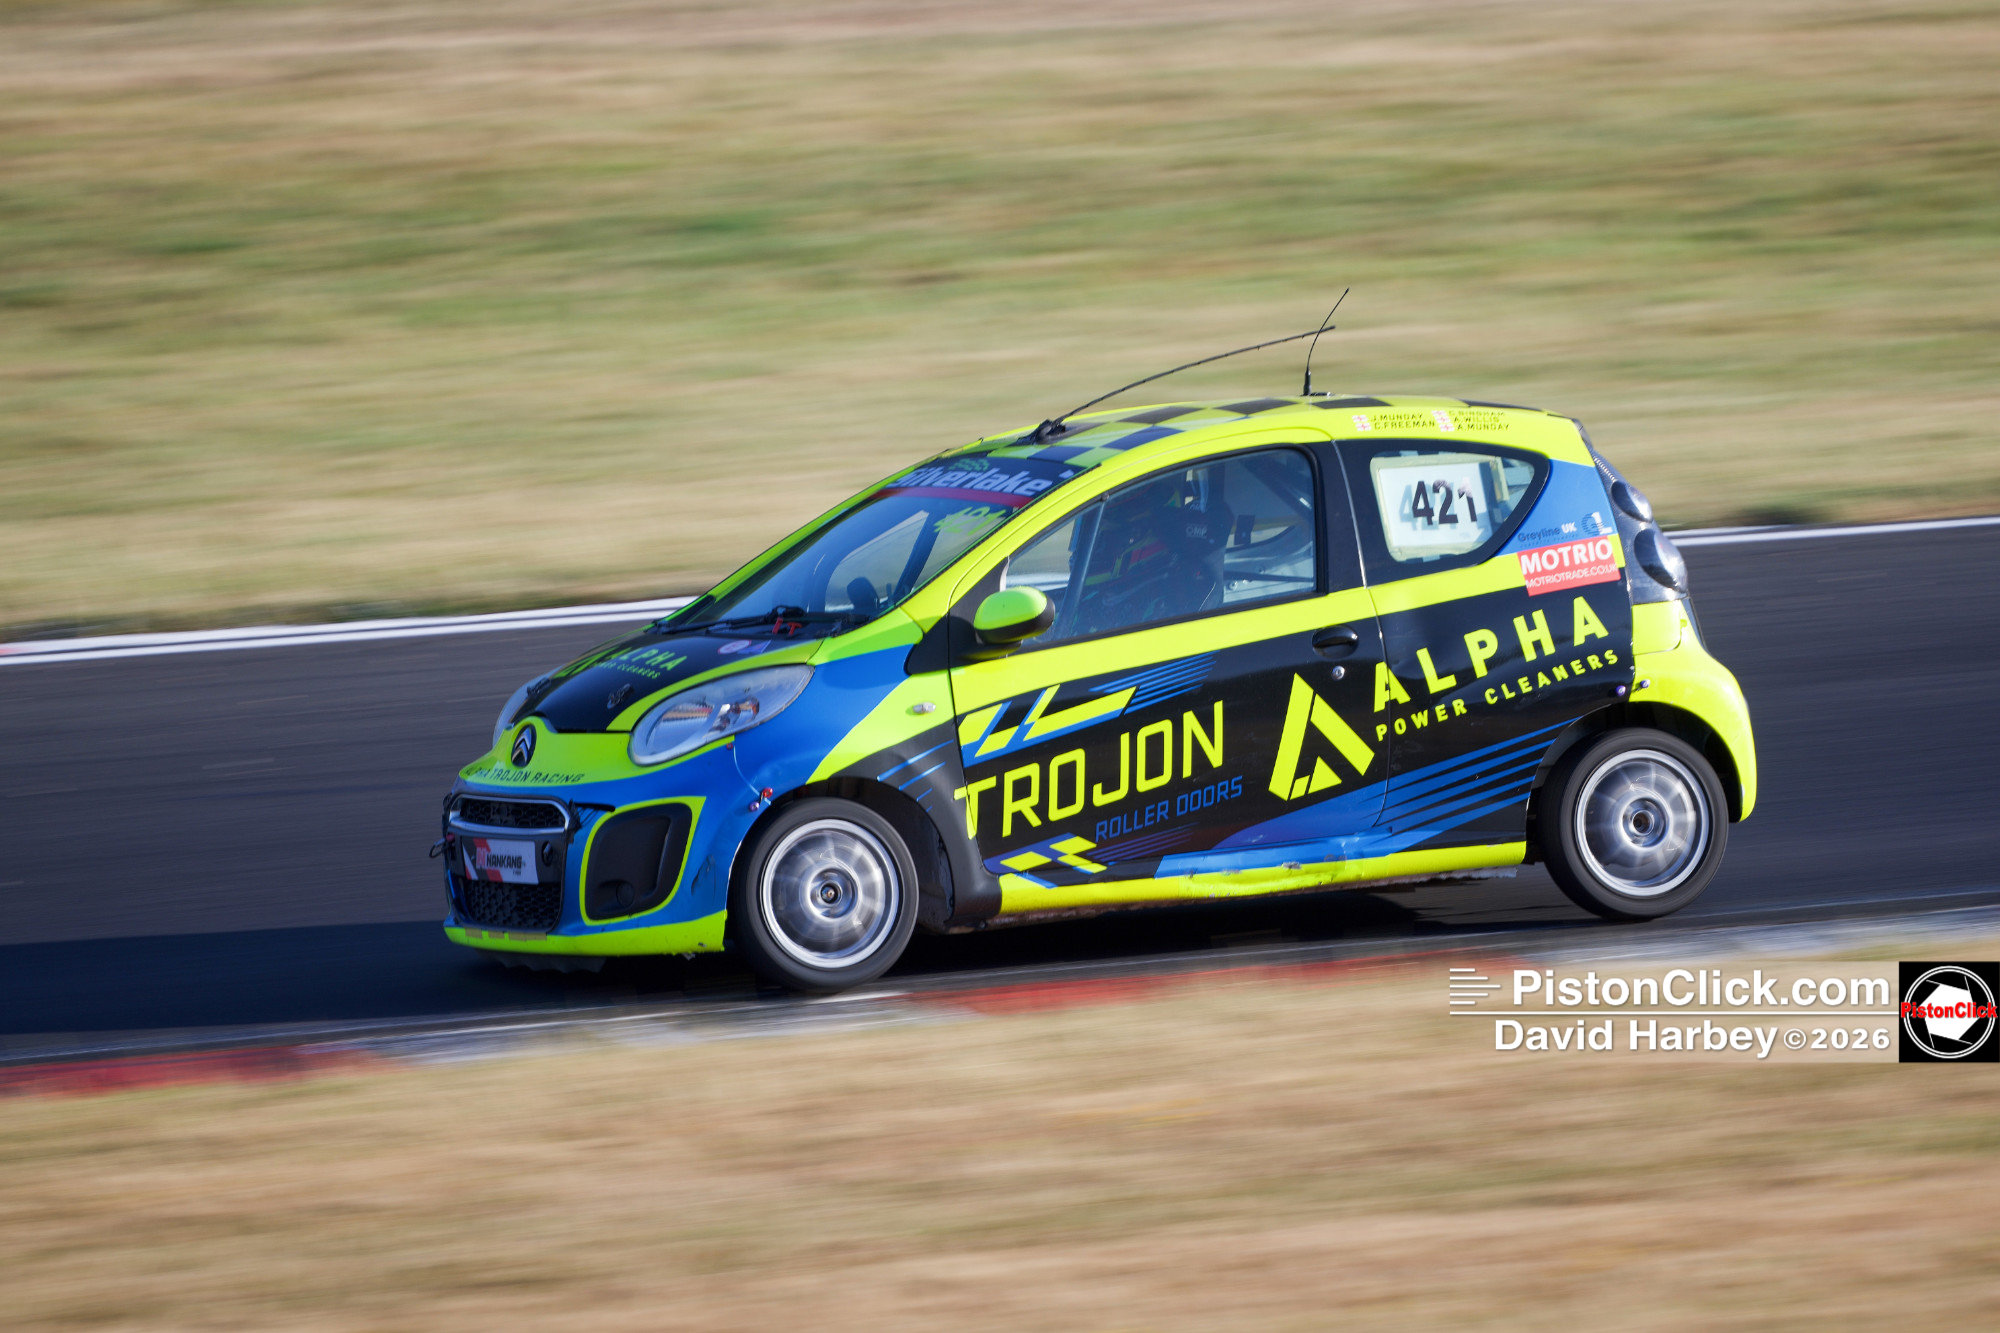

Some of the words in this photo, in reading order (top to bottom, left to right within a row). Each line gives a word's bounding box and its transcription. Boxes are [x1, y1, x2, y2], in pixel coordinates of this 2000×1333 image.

[933, 506, 1007, 536] 421
[1411, 480, 1478, 526] 421
[1518, 526, 1560, 542] Greyline
[1561, 521, 1578, 534] UK
[1520, 538, 1613, 576] MOTRIO
[1373, 596, 1609, 713] ALPHA
[1375, 698, 1468, 743] POWER
[1484, 649, 1619, 706] CLEANERS
[953, 700, 1224, 841] TROJON
[1095, 800, 1169, 843] ROLLER
[1176, 775, 1243, 816] DOORS
[486, 853, 523, 869] NANKANG
